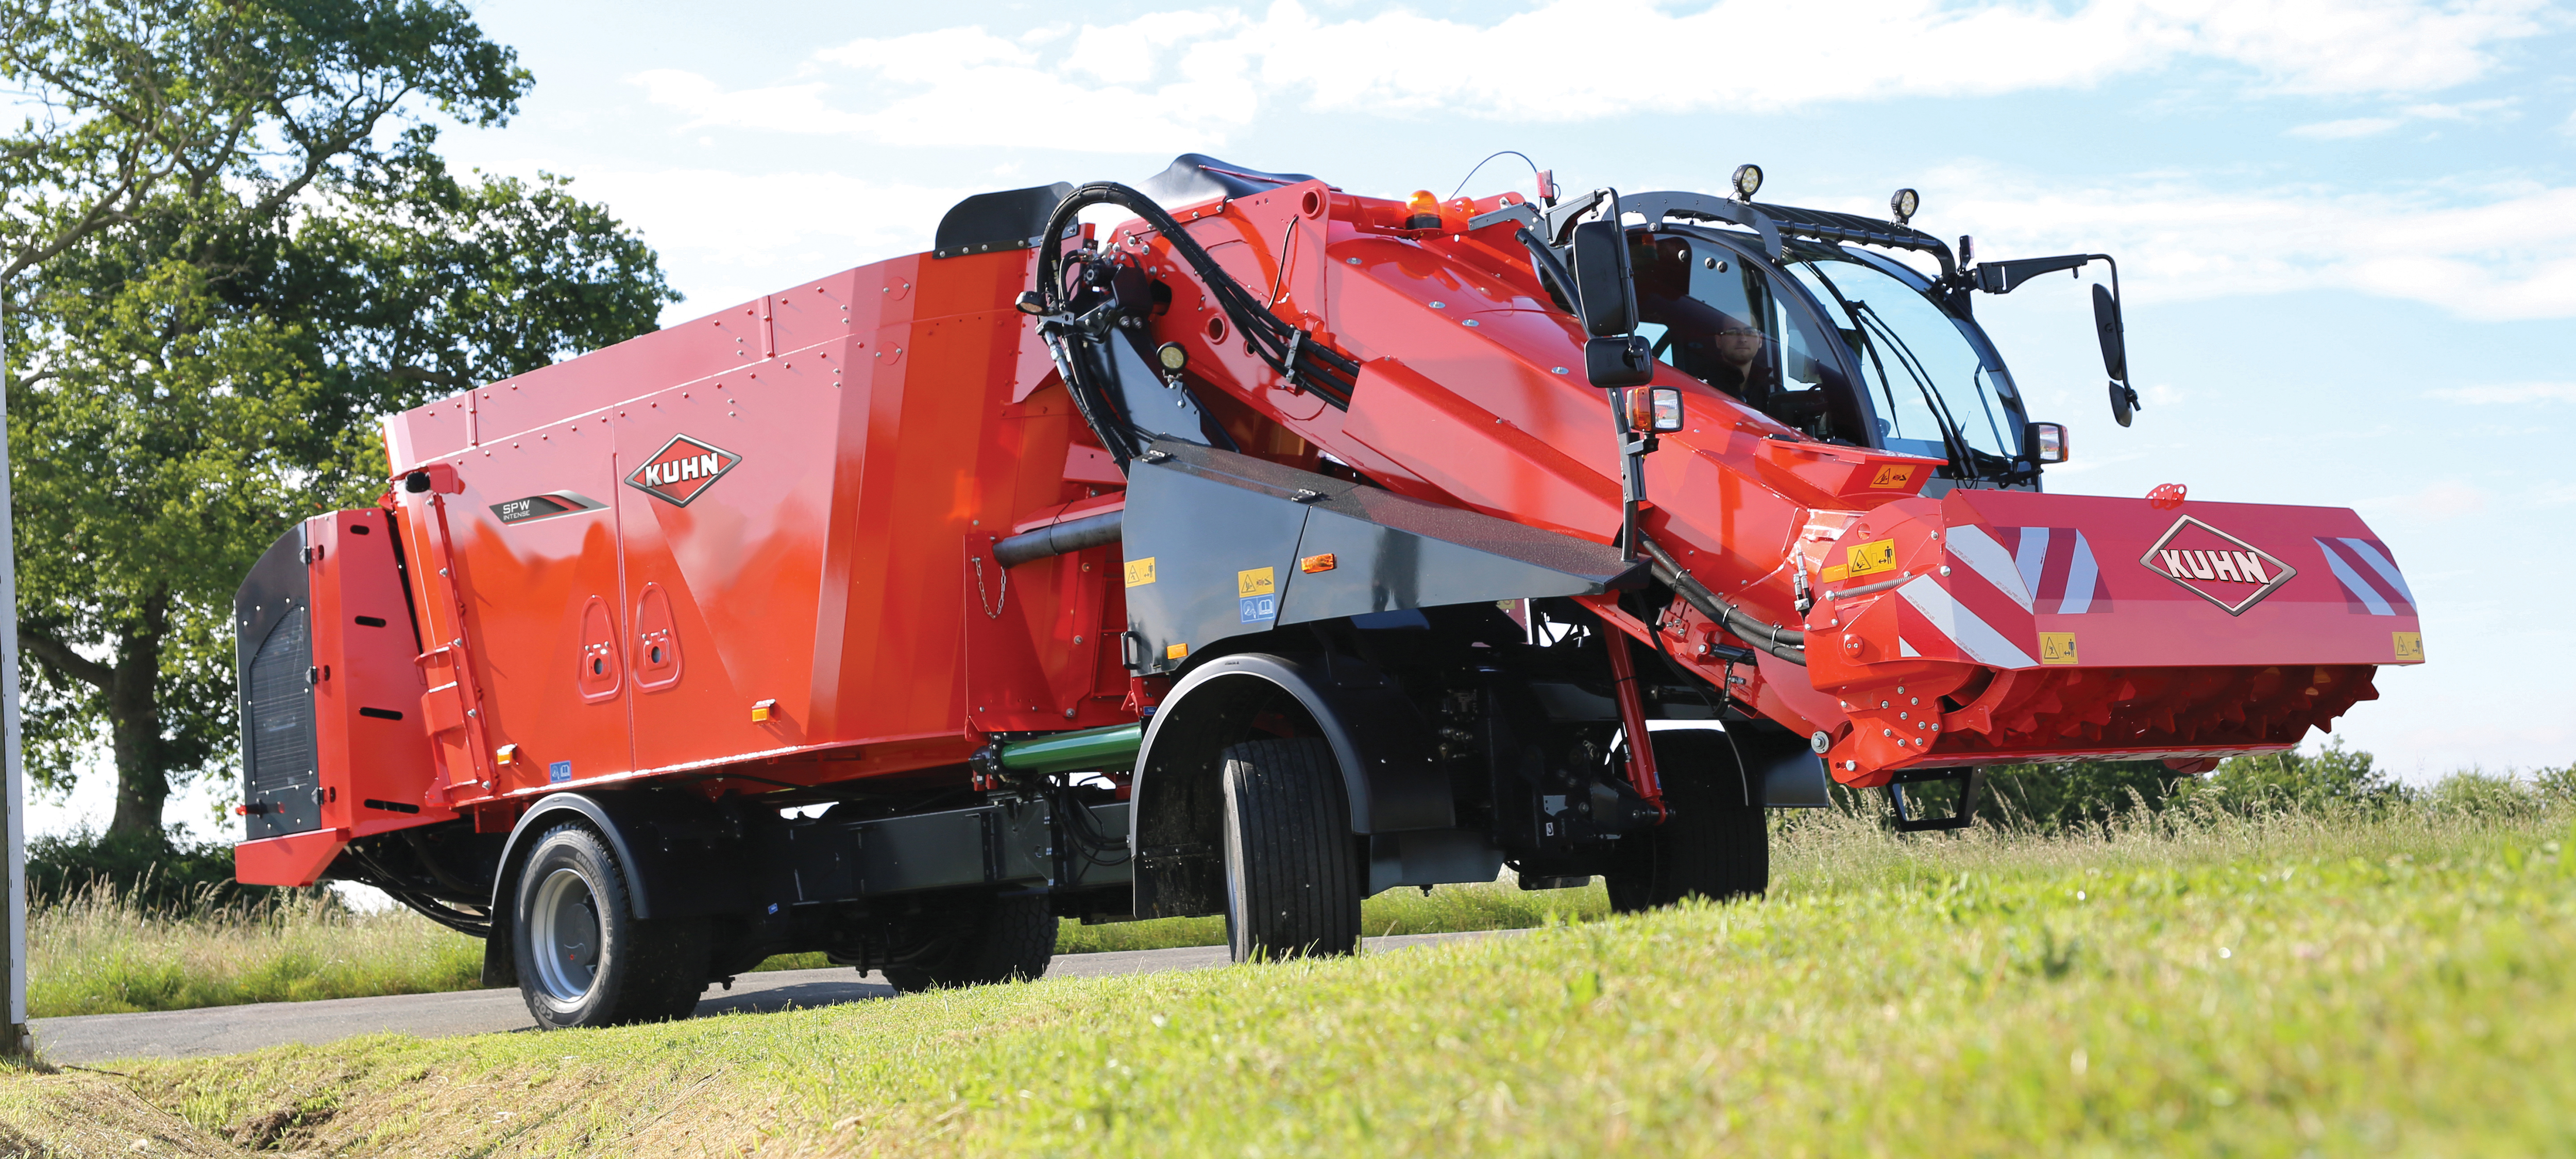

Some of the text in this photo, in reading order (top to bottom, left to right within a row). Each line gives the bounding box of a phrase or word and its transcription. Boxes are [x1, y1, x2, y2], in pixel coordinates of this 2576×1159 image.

[645, 452, 719, 487] KUHN
[503, 500, 530, 514] SPW
[503, 510, 530, 520] INTENSE
[2159, 549, 2270, 585] KUHN
[575, 851, 607, 902] OMNITRAC
